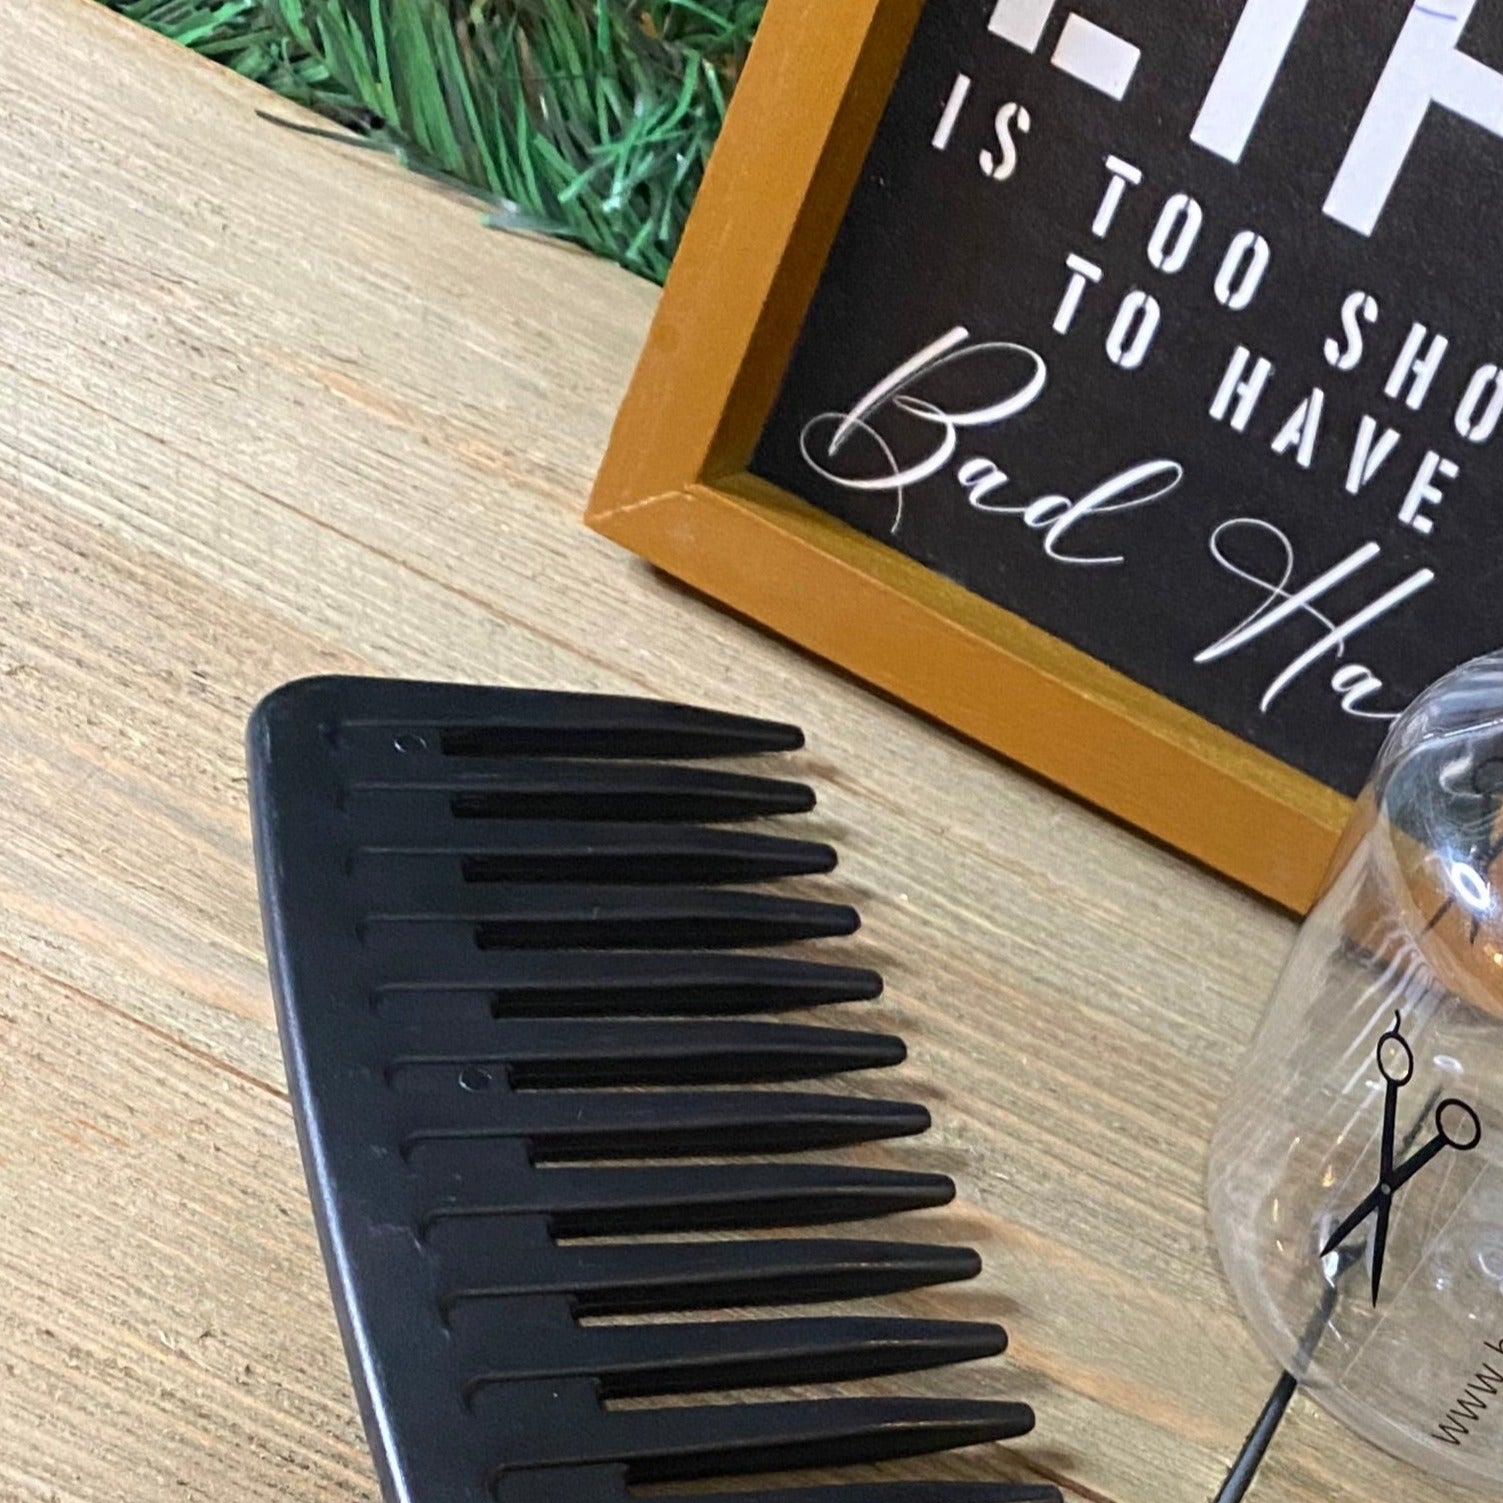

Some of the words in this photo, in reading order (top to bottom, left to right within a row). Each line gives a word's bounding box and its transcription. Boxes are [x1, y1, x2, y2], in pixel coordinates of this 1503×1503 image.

[931, 74, 1031, 181] IS
[1091, 154, 1272, 313] TOO
[800, 325, 1184, 565] Bad
[1193, 516, 1436, 719] Ha
[1051, 252, 1162, 371] TO
[1208, 345, 1461, 535] HAVE
